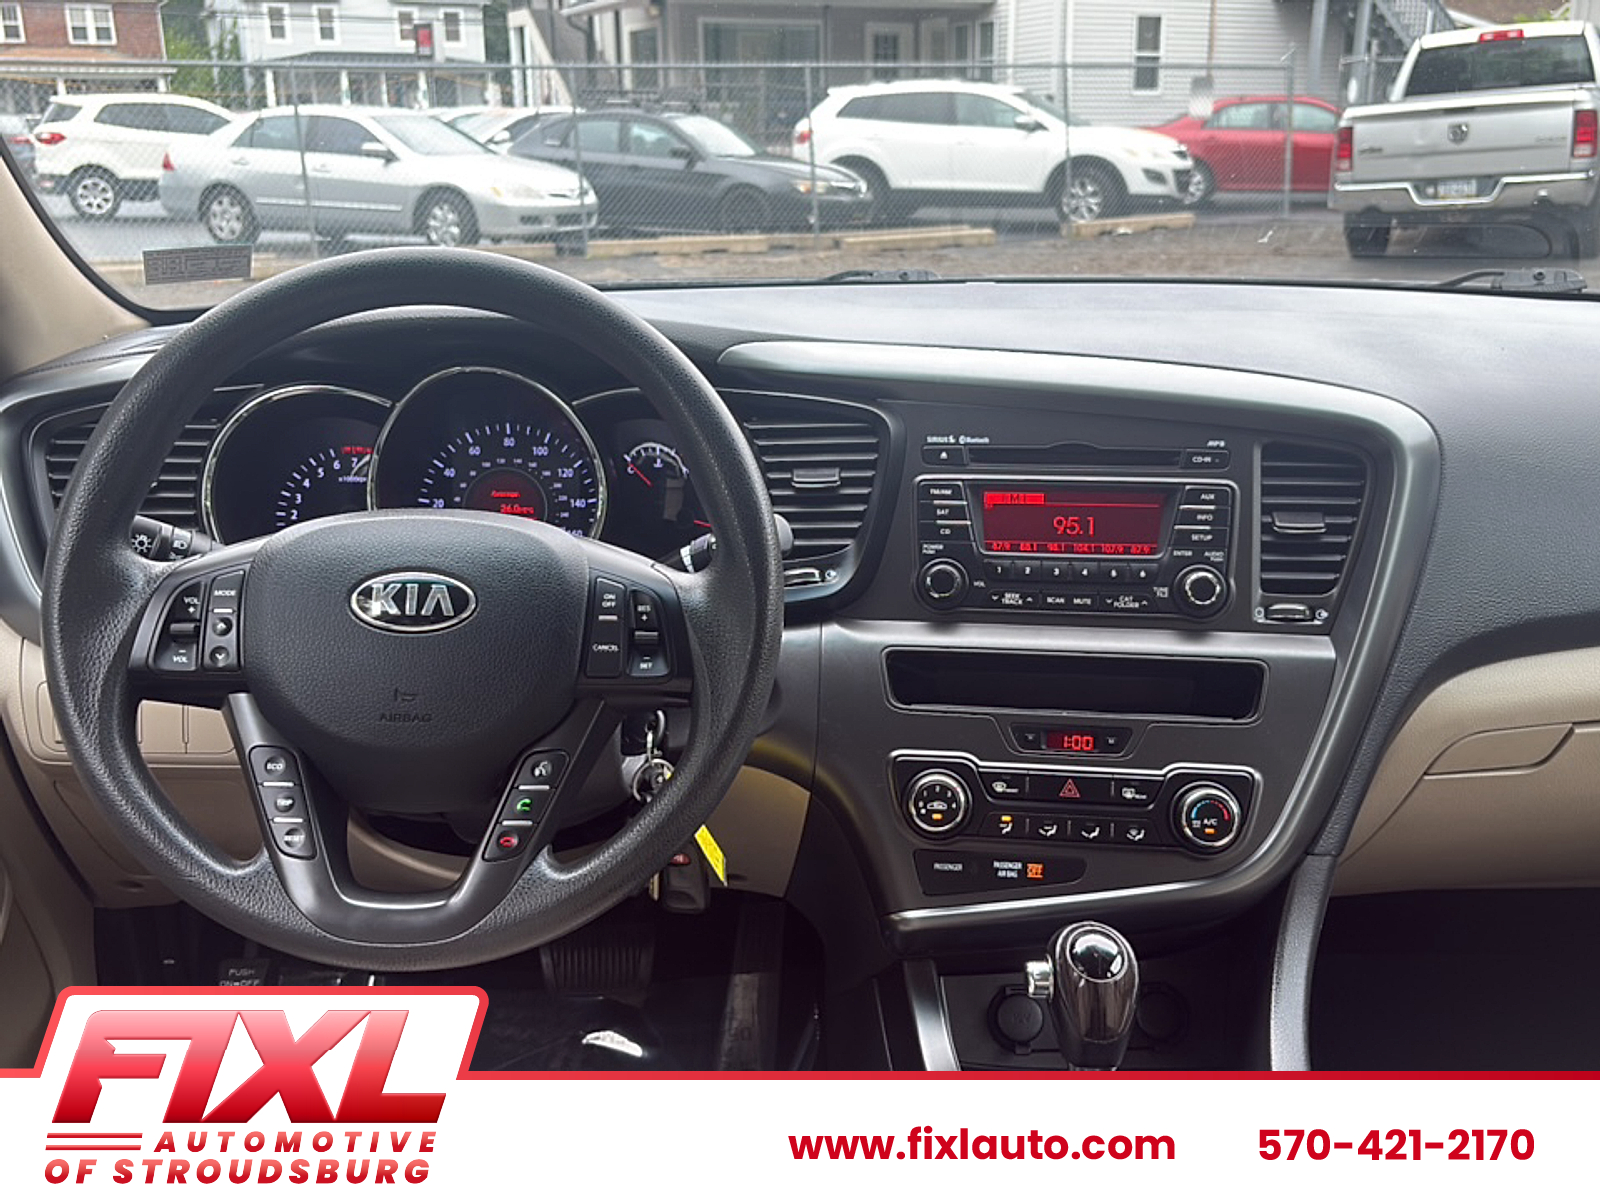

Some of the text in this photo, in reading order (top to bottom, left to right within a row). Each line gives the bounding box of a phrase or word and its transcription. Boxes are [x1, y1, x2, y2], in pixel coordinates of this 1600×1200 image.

[503, 437, 516, 447] 80
[468, 446, 482, 456] 60
[532, 446, 550, 456] 100
[333, 460, 341, 470] 6
[351, 457, 358, 468] 7
[317, 467, 325, 478] 5
[443, 468, 456, 479] 40
[557, 468, 575, 478] 120
[302, 478, 311, 488] 4
[295, 493, 302, 504] 3
[432, 498, 445, 508] 20
[570, 499, 587, 508] 140
[290, 509, 298, 520] 2
[1053, 516, 1095, 537] 95.1
[996, 566, 1002, 574] 1
[1025, 566, 1031, 575] 2
[1054, 567, 1060, 576] 3
[1082, 568, 1088, 577] 4
[1111, 569, 1117, 578] 5
[1139, 569, 1146, 578] 6
[371, 583, 455, 616] KIA
[592, 644, 619, 652] CANCEL
[172, 655, 188, 663] VOL
[379, 713, 433, 723] AIRBAG
[1062, 735, 1095, 751] 1:00
[1203, 818, 1218, 826] A/C
[993, 861, 1023, 869] PASSENGER
[228, 968, 255, 976] PUSH
